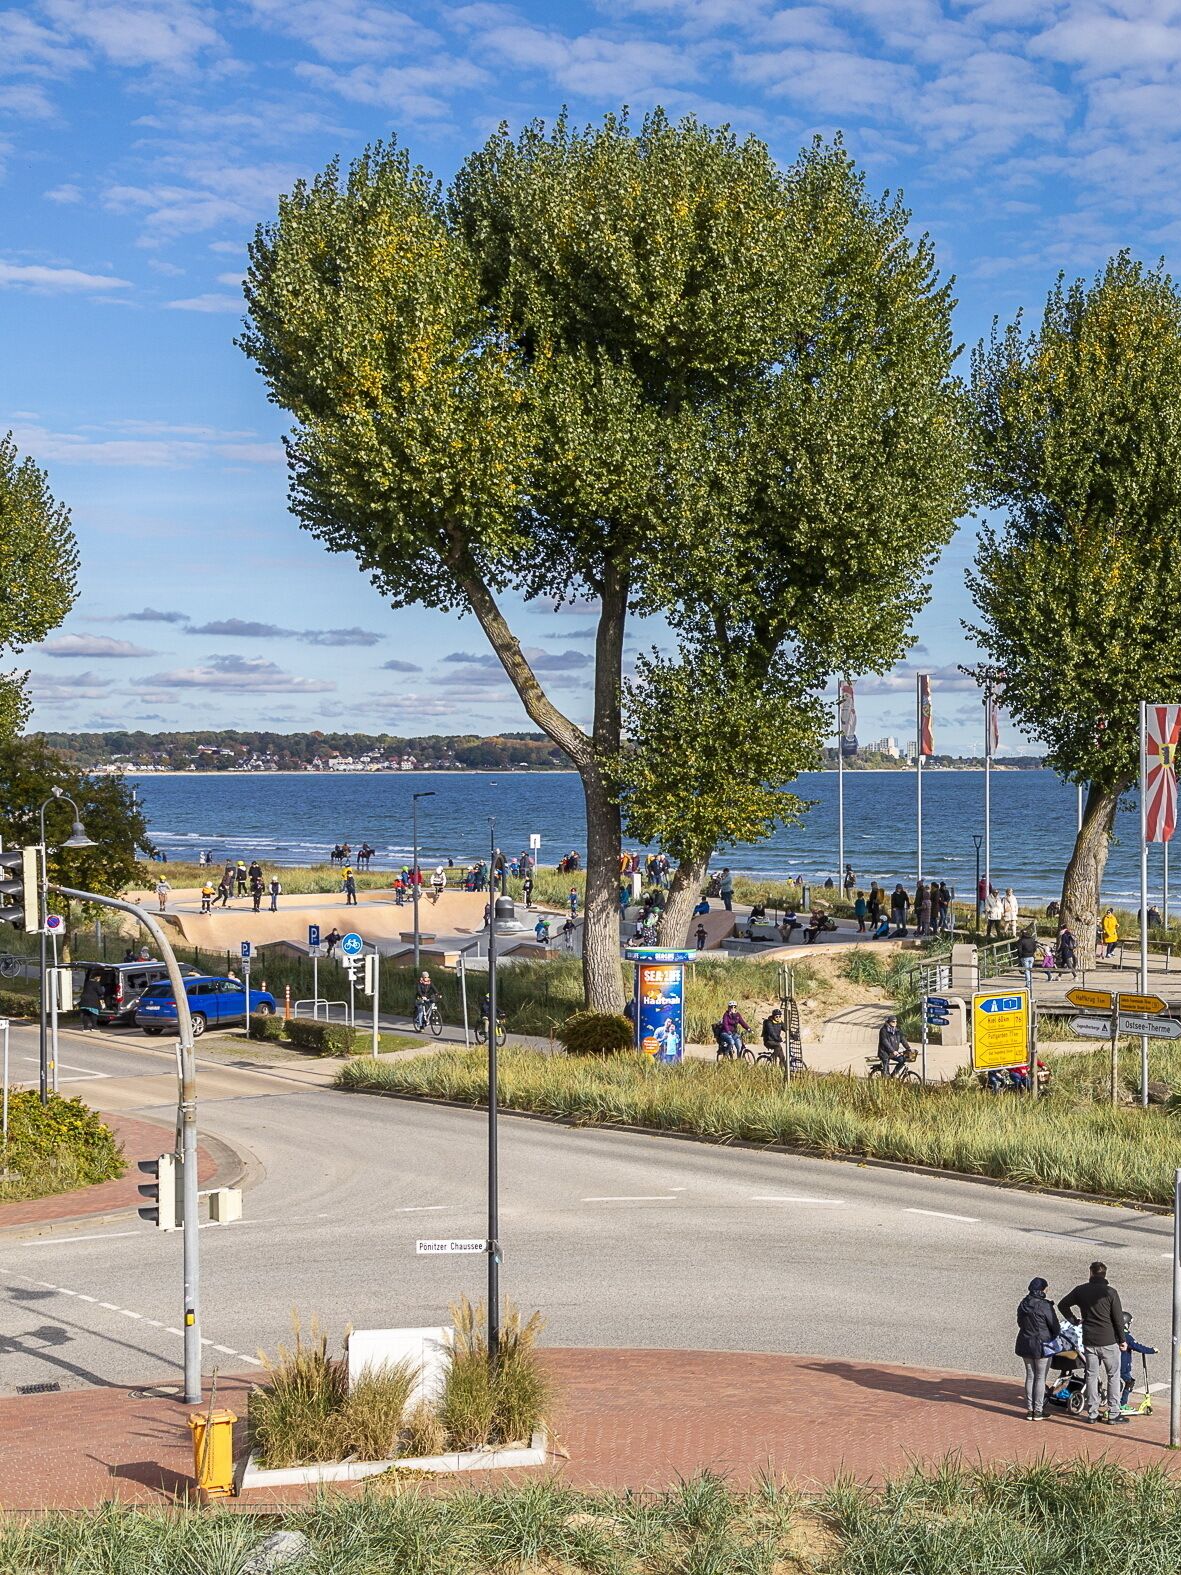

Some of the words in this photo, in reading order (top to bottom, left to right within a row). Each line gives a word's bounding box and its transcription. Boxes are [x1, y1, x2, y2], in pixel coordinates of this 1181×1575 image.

[1125, 1020, 1171, 1034] Ostsee-Therme
[419, 1242, 447, 1251] Pönitzer
[450, 1242, 483, 1251] Chaussee
